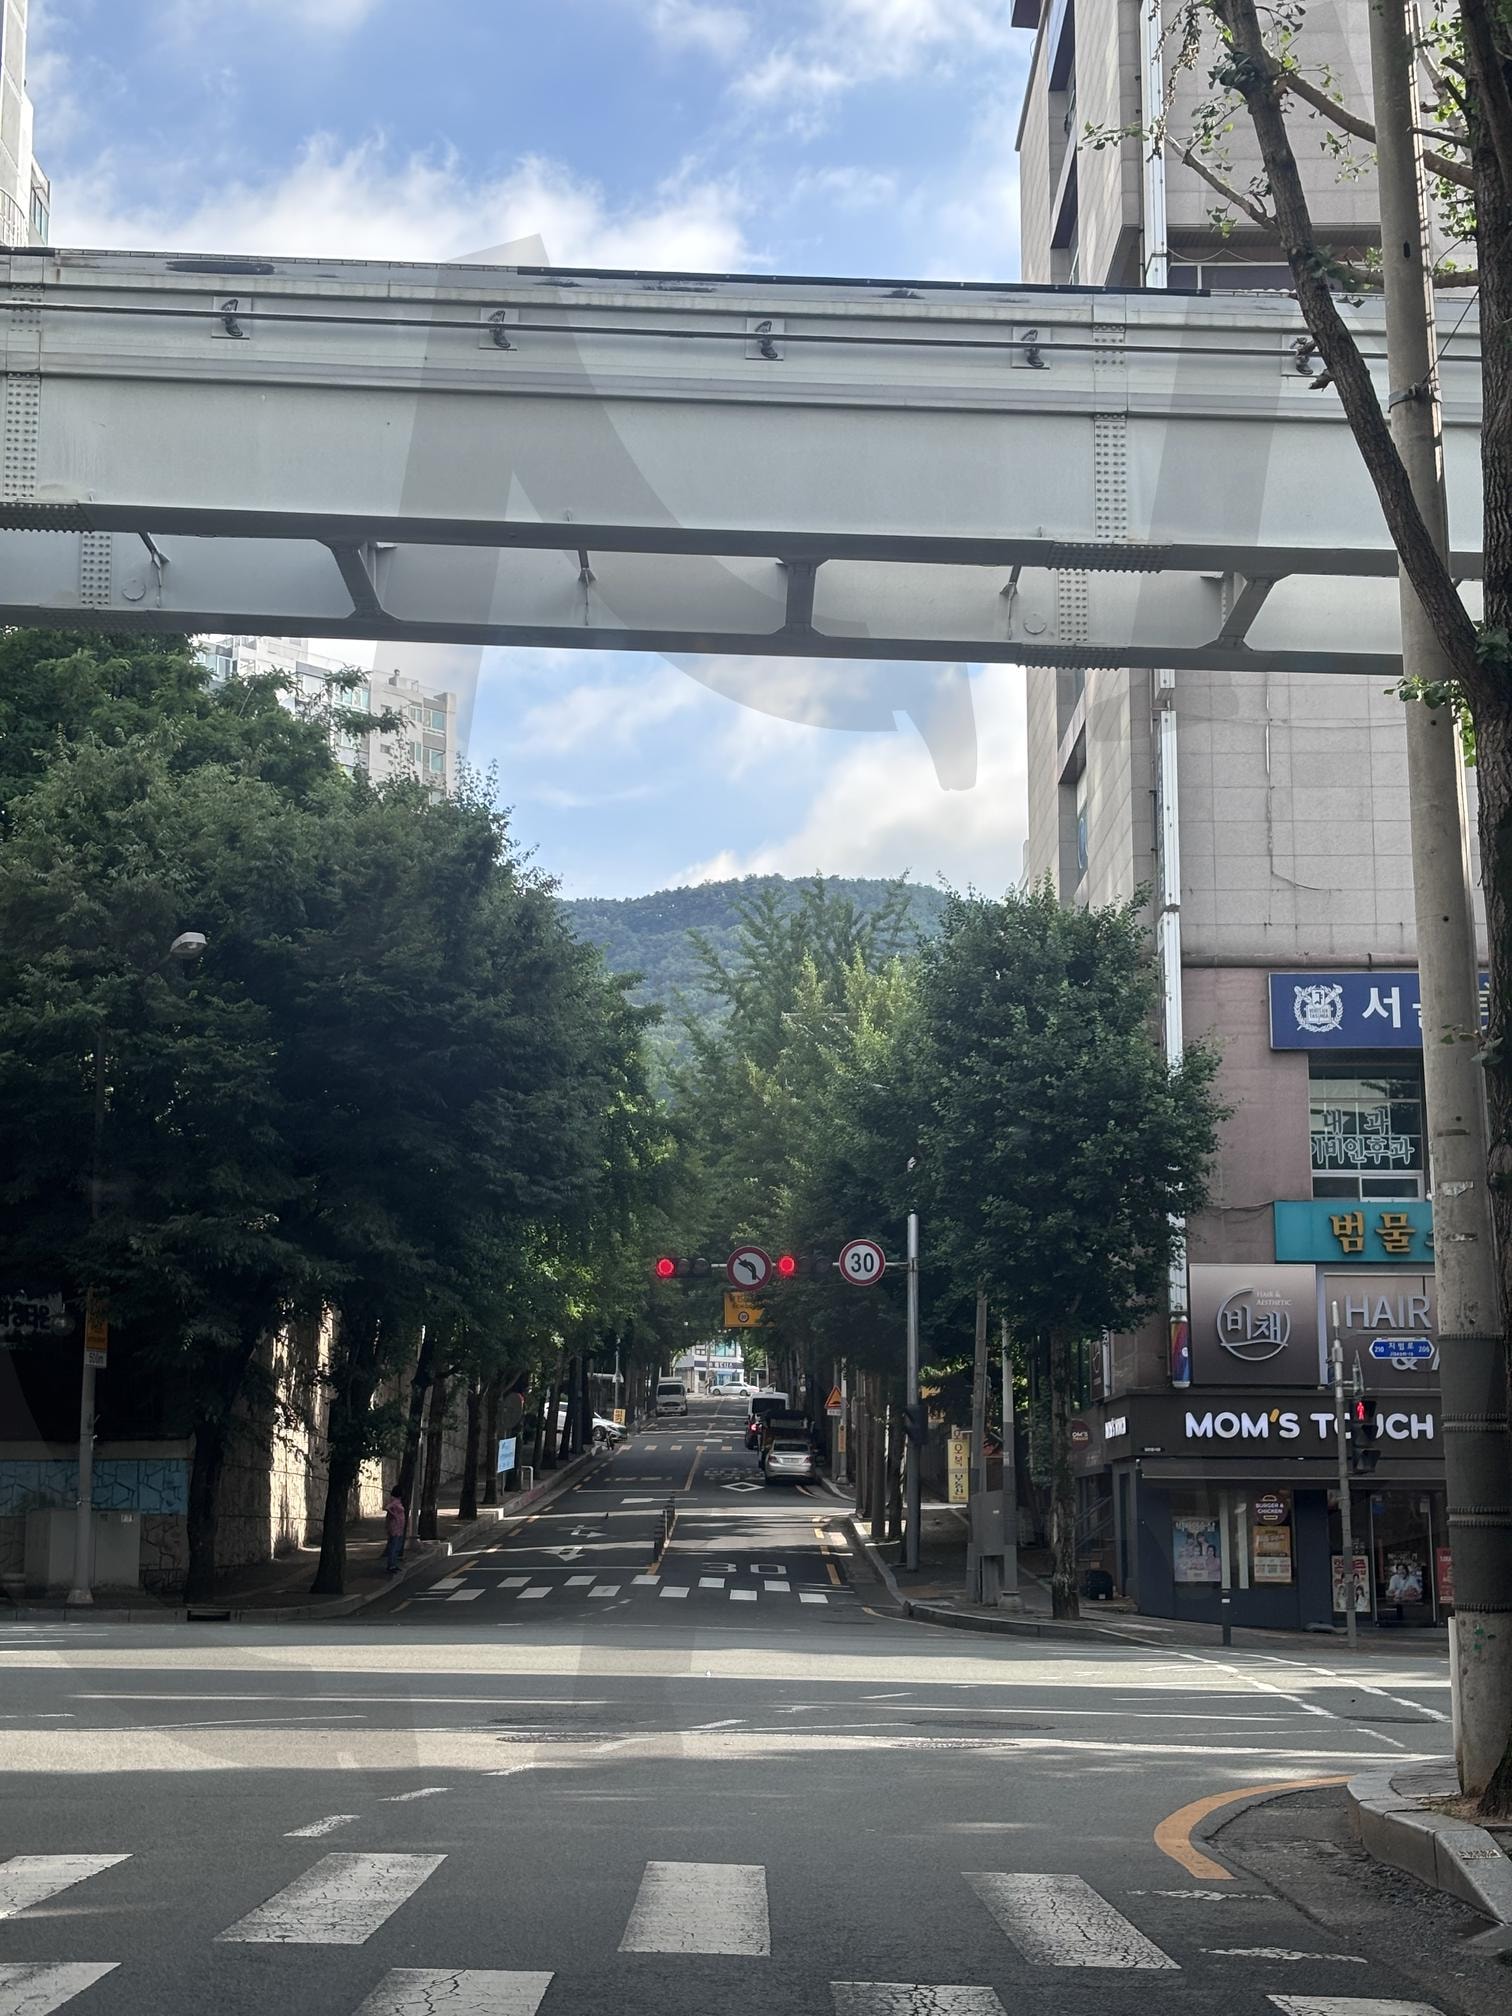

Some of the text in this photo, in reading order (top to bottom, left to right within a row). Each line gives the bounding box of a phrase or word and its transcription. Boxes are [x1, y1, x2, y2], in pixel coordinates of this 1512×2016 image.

[1329, 1211, 1434, 1253] 범물
[851, 1252, 875, 1273] 30
[1223, 1304, 1282, 1341] 비채
[1345, 1295, 1432, 1328] HAIR
[1185, 1408, 1301, 1439] MOM'S
[701, 1562, 787, 1575] 30
